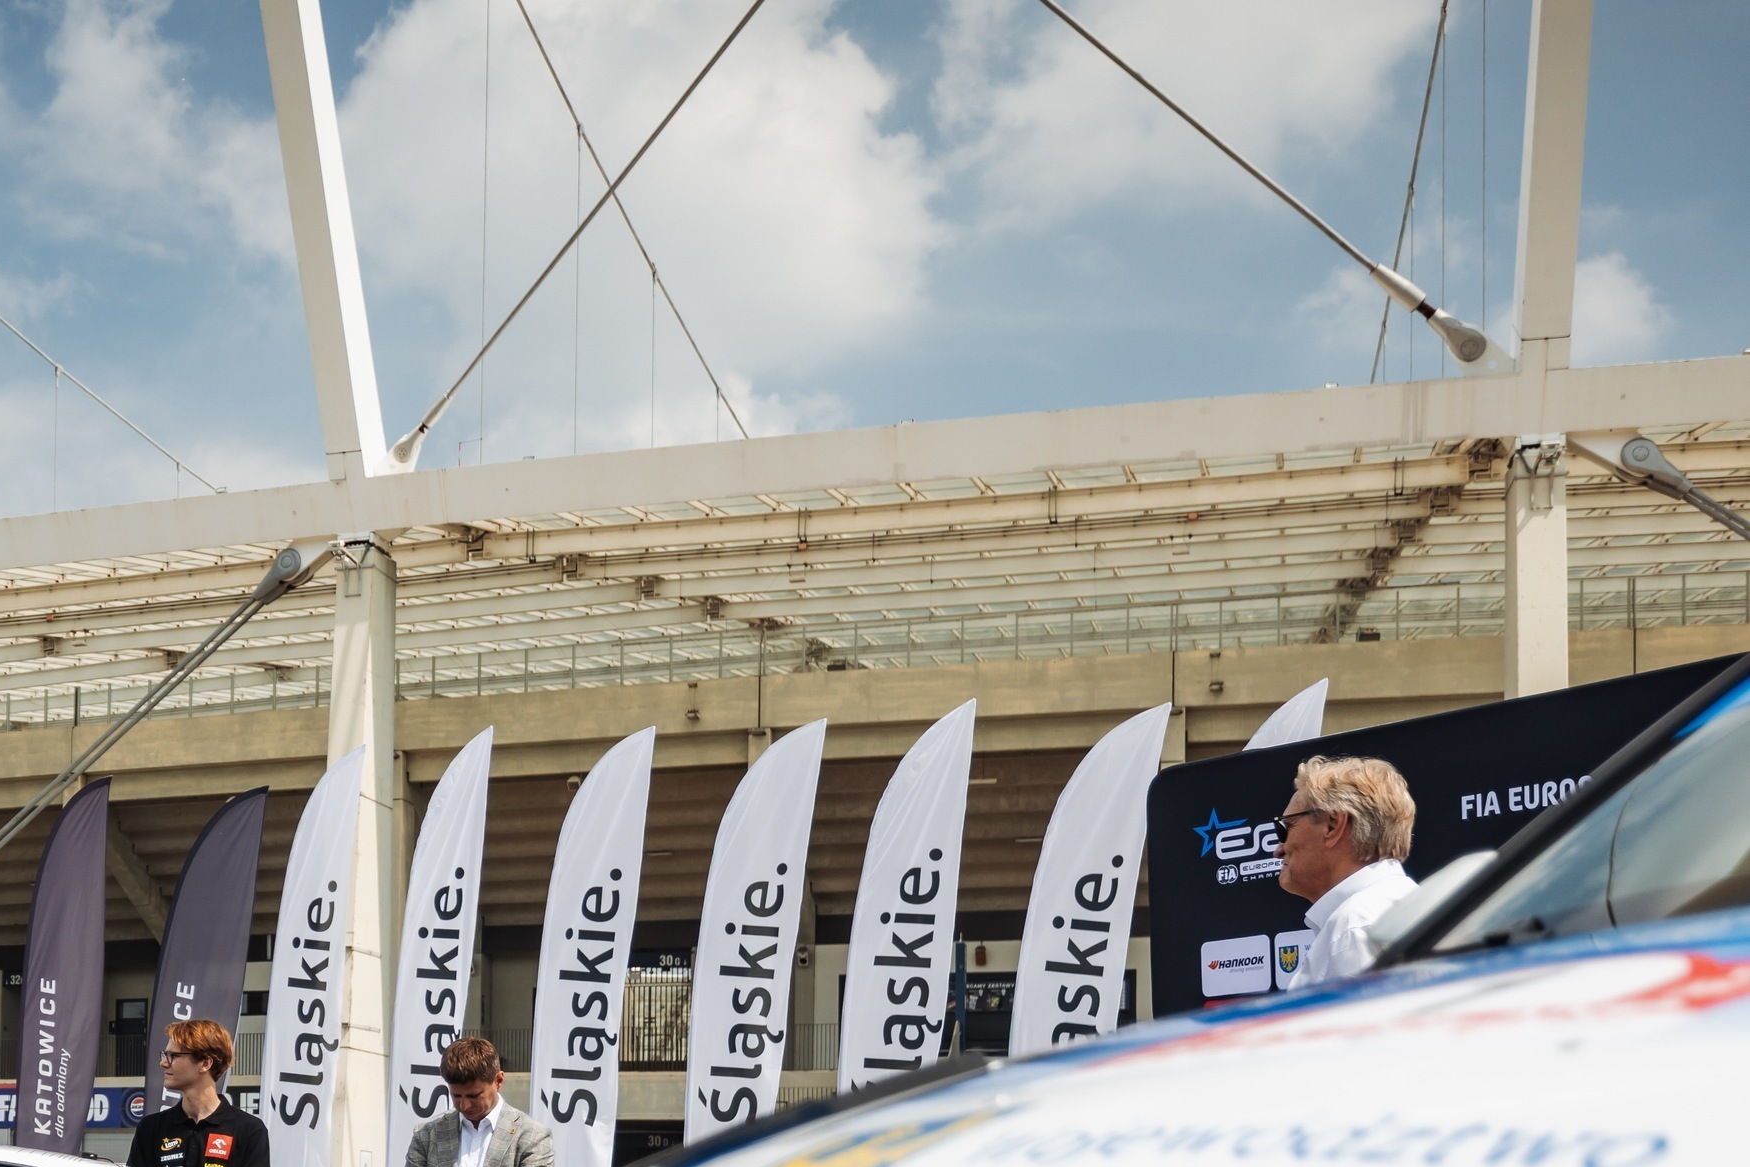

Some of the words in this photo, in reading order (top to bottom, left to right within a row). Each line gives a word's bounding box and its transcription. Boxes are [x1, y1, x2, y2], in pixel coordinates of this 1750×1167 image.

[1461, 790, 1501, 820] FIA
[34, 978, 56, 1136] KATOWICE
[271, 880, 338, 1130] Śląskie.
[541, 868, 622, 1127] Śląskie.
[698, 863, 787, 1124] Śląskie.
[851, 848, 943, 1092] ląskie.
[54, 1115, 65, 1138] dla
[55, 1048, 71, 1112] odmiany
